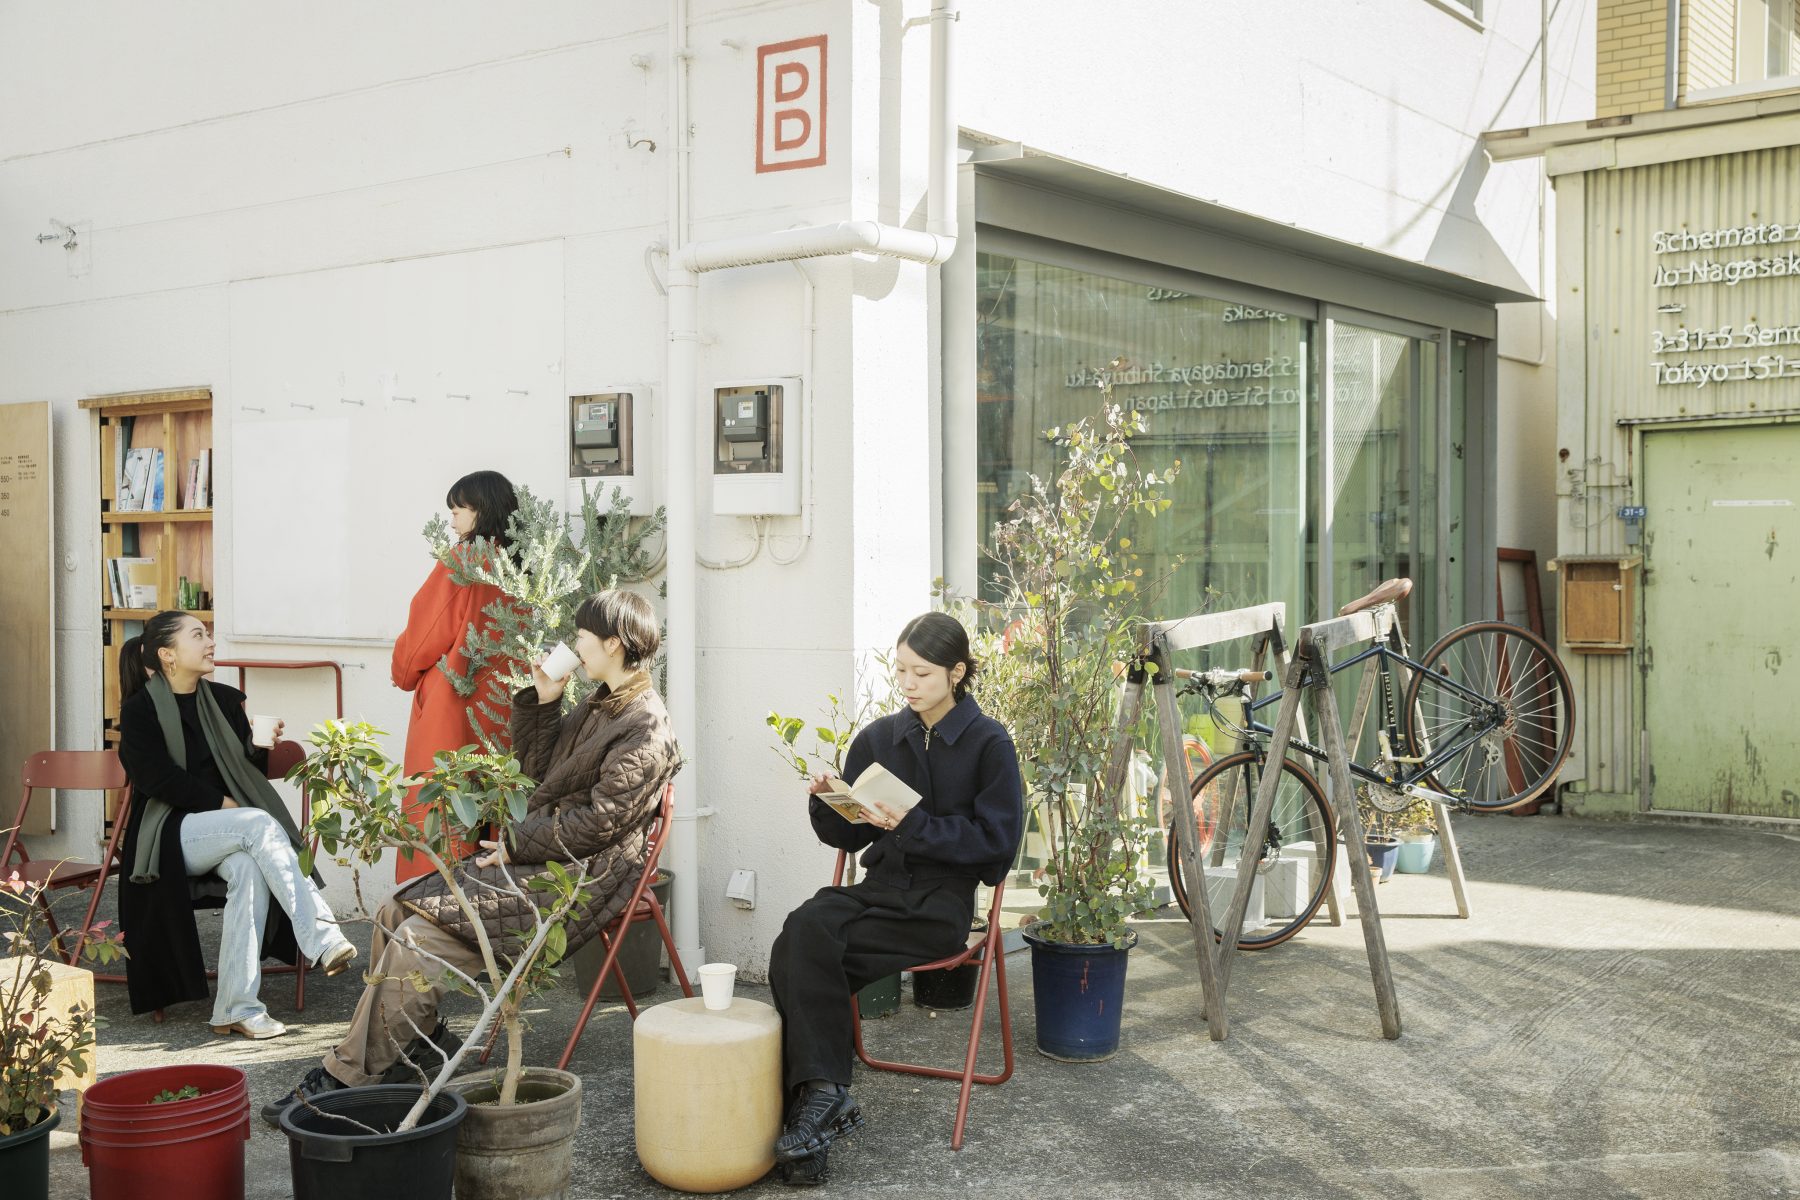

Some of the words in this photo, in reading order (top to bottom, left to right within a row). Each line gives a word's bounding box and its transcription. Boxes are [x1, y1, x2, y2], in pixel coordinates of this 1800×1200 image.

[1653, 223, 1783, 254] Schemata
[1653, 265, 1679, 288] Jo
[1652, 326, 1732, 353] 3-31-5
[1651, 361, 1729, 388] Tokyo
